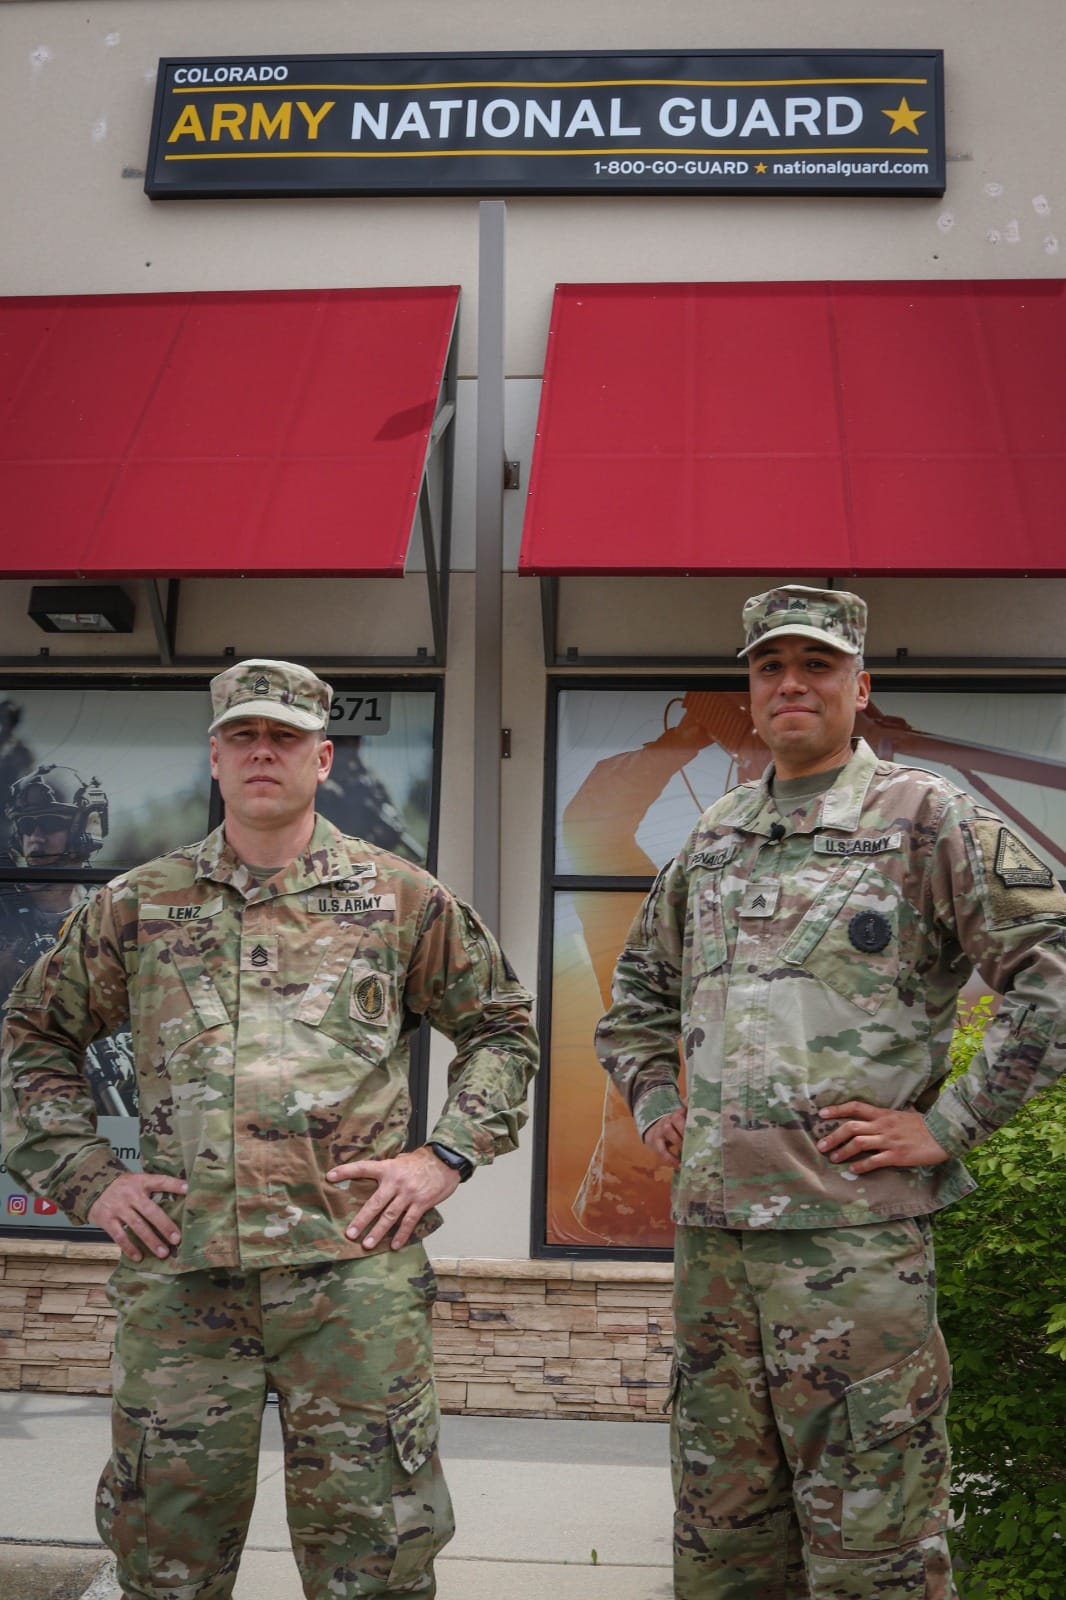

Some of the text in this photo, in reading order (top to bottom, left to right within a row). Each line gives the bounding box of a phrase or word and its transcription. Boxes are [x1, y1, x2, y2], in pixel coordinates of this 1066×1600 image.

[174, 66, 288, 84] COLORADO
[167, 96, 864, 143] ARMY NATIONAL GUARD
[594, 160, 929, 177] 1-800-GO-GUARD nationalguard.com
[168, 905, 202, 919] LENZ
